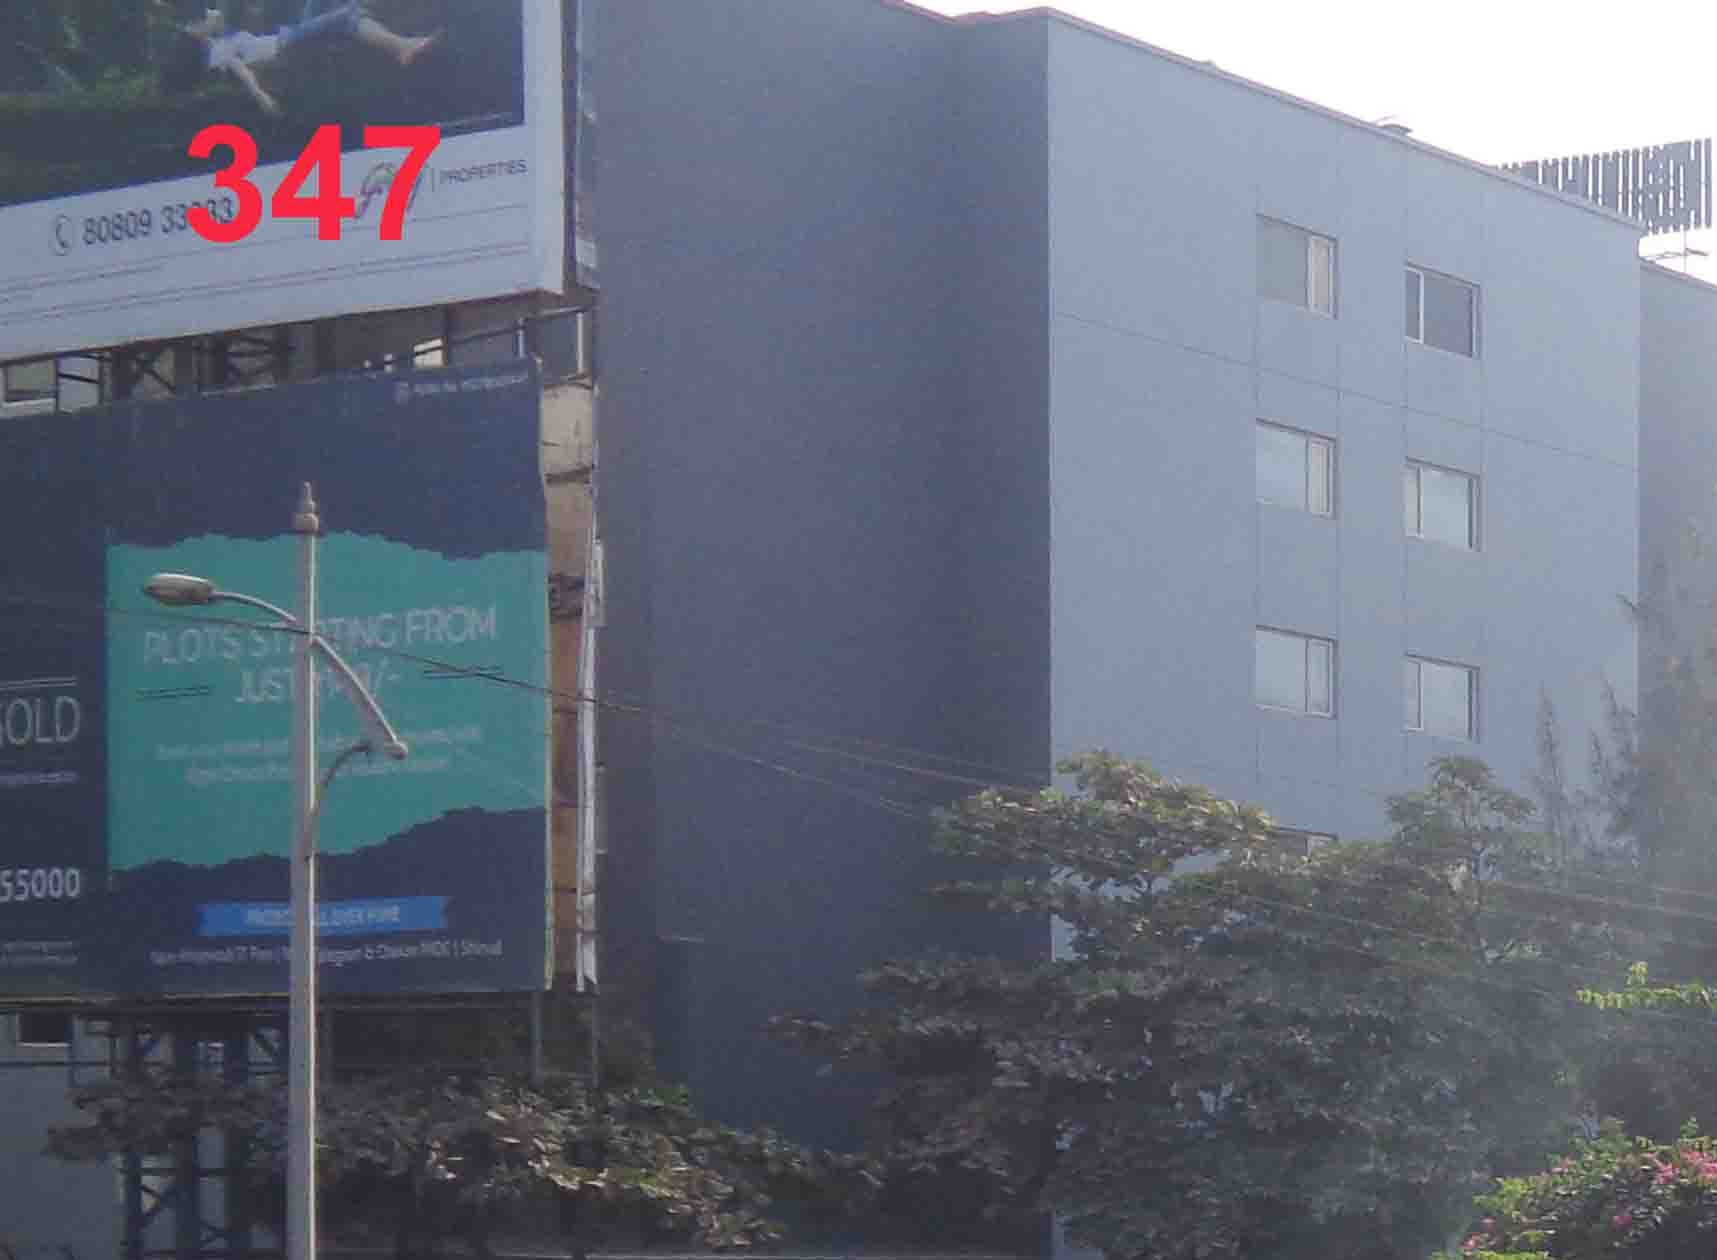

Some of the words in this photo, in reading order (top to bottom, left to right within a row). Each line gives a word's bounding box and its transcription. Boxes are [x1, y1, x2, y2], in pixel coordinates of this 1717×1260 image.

[82, 208, 152, 247] 80809
[144, 625, 243, 667] PLOTS
[250, 614, 397, 660] STTING
[404, 603, 498, 645] FROM
[0, 694, 81, 746] OLD
